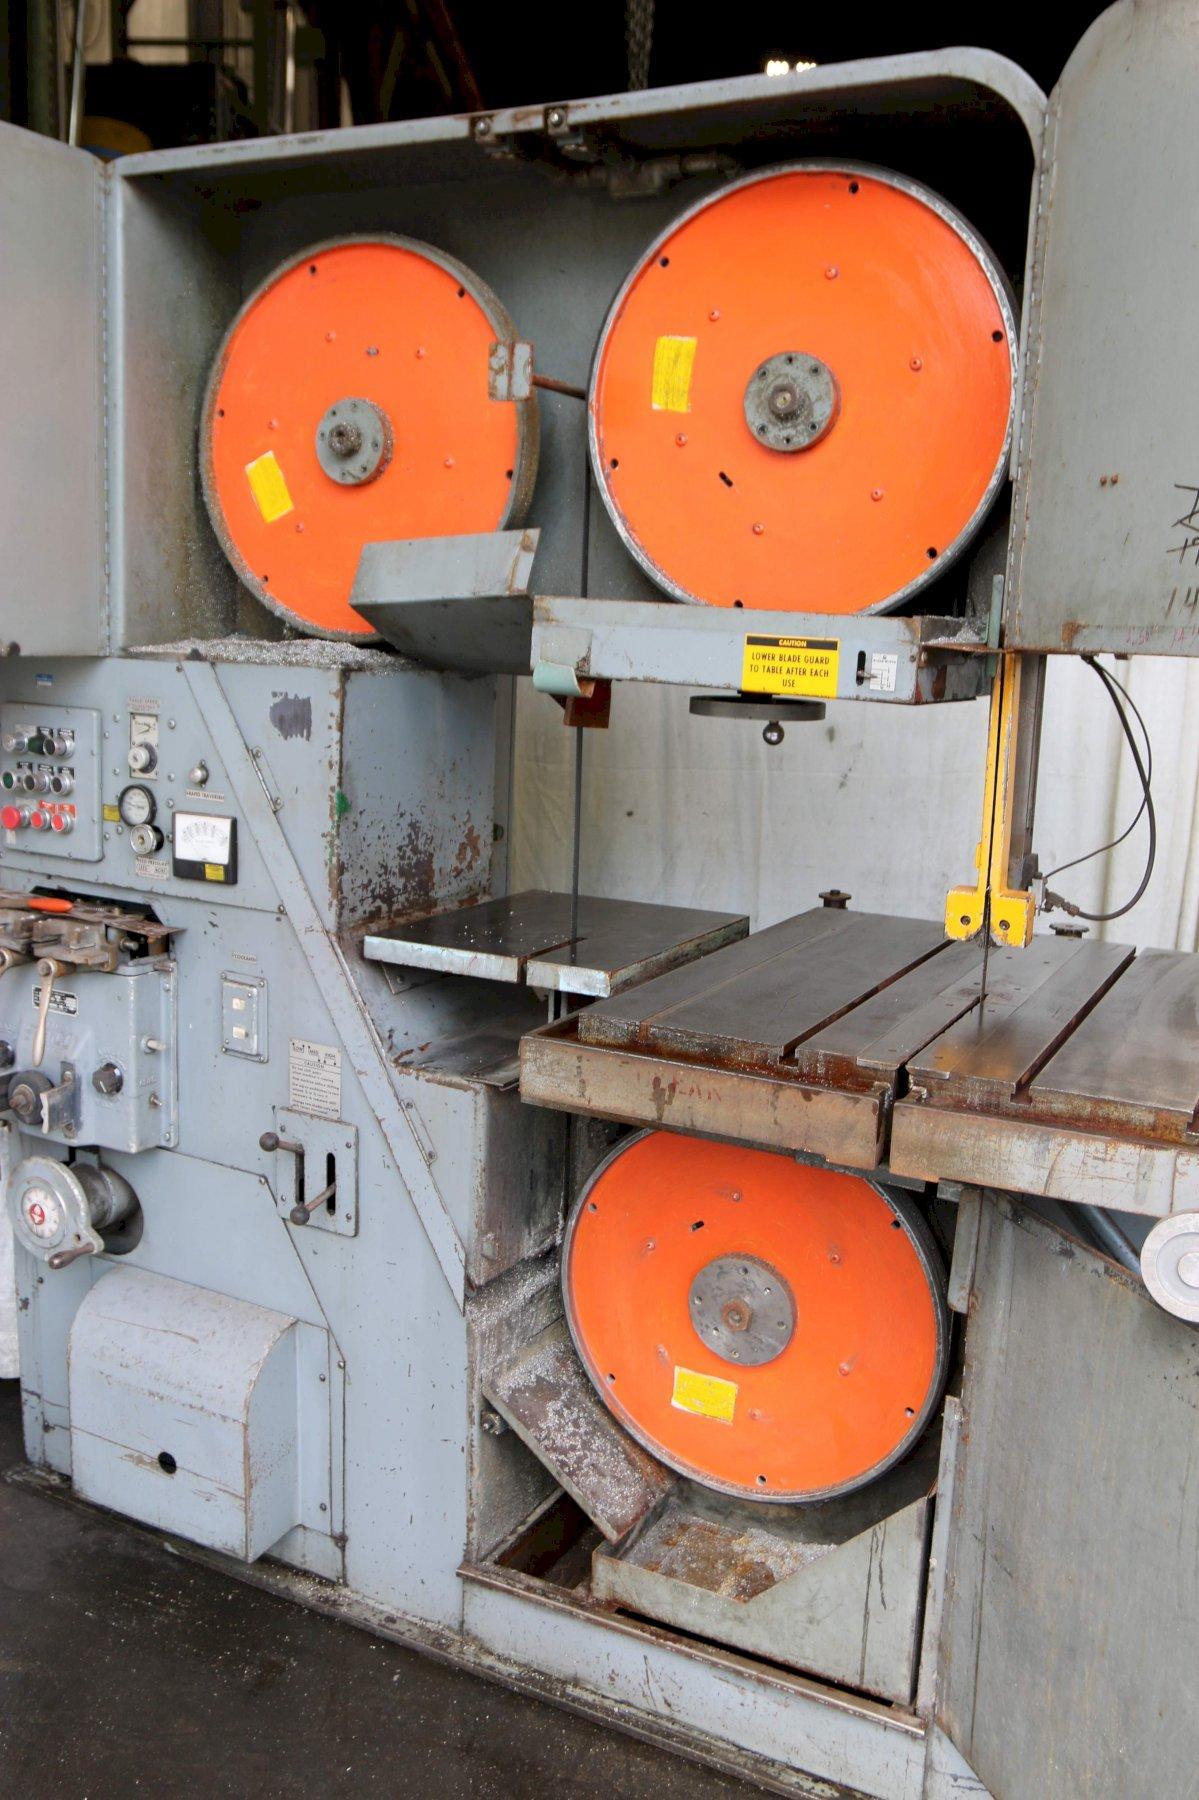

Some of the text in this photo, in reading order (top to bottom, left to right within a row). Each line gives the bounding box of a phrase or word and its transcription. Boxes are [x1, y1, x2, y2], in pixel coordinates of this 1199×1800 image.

[779, 639, 807, 648] CAUTION
[751, 652, 830, 665] LOWER BLADE GUARD
[750, 664, 829, 678] TO TABLE AFTER EACH
[782, 678, 796, 688] USE
